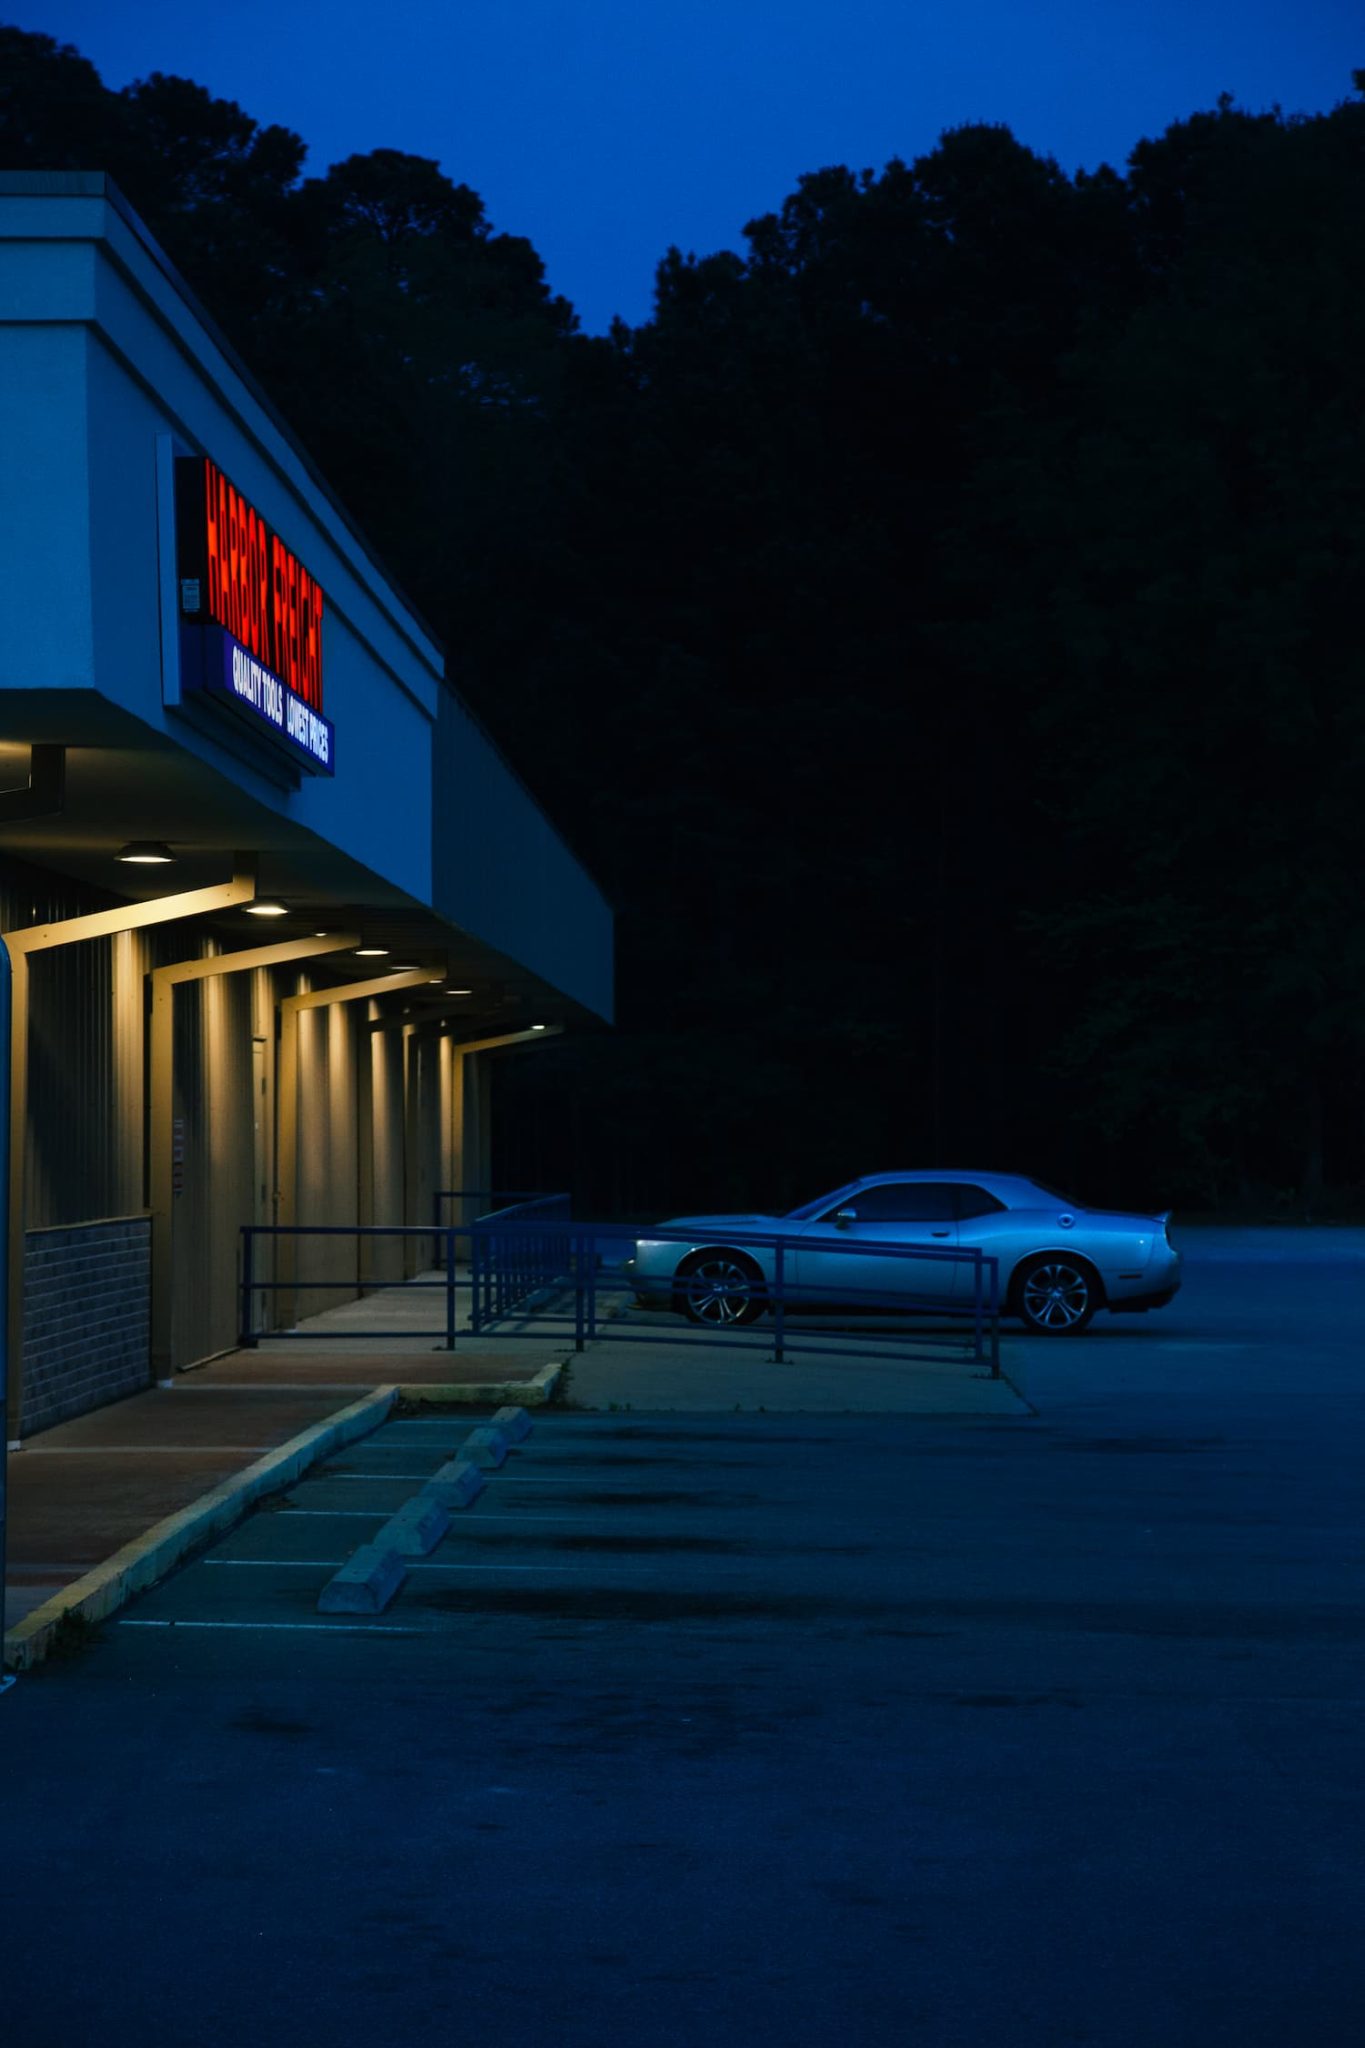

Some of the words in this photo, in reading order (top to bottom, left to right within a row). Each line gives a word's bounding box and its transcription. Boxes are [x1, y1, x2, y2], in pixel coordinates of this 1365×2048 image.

[205, 457, 270, 667] HARBOR
[272, 534, 323, 715] FREIGHT
[232, 645, 262, 708] QUALITY
[262, 670, 283, 727] TOOLS
[286, 692, 309, 748] LOWEST
[309, 712, 329, 764] PRICES
